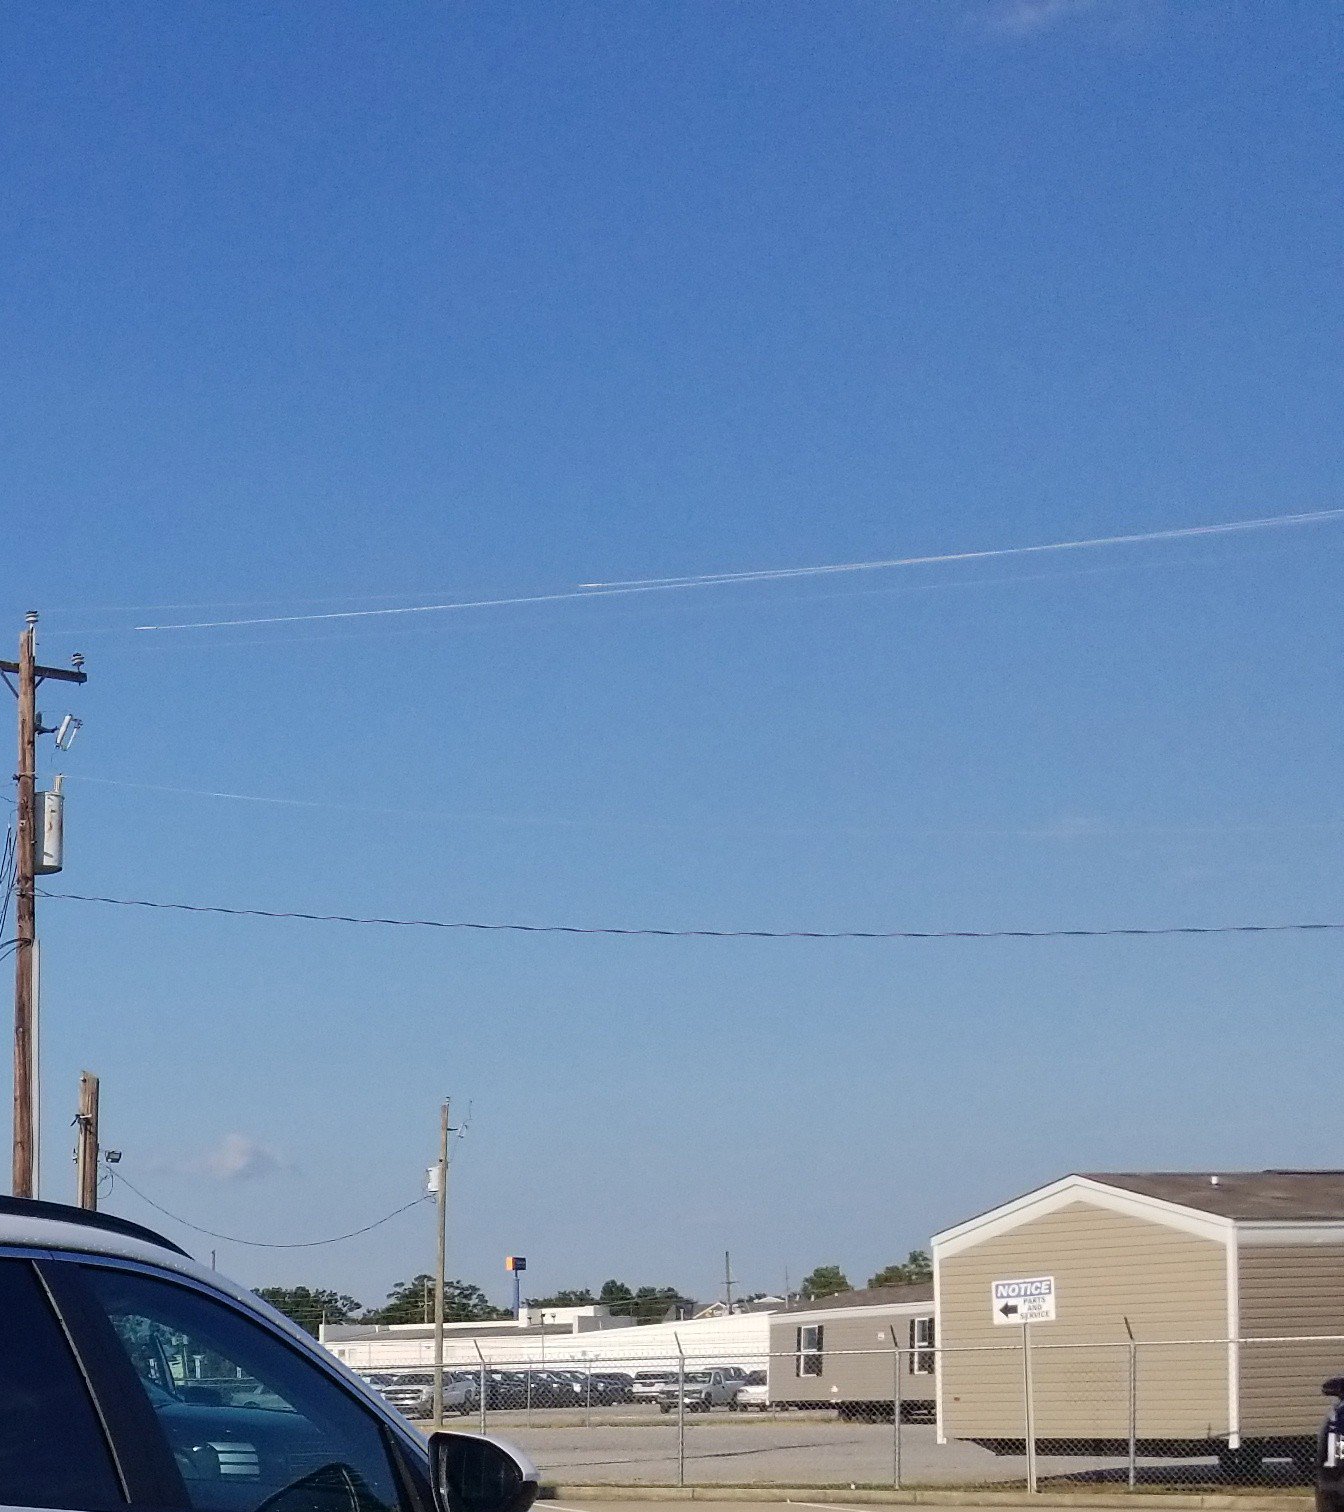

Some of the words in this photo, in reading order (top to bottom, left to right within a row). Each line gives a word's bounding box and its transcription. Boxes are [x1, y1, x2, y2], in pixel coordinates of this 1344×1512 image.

[996, 1281, 1051, 1297] NOTICE
[1023, 1296, 1046, 1305] PARTS
[1020, 1310, 1051, 1320] SERVICE
